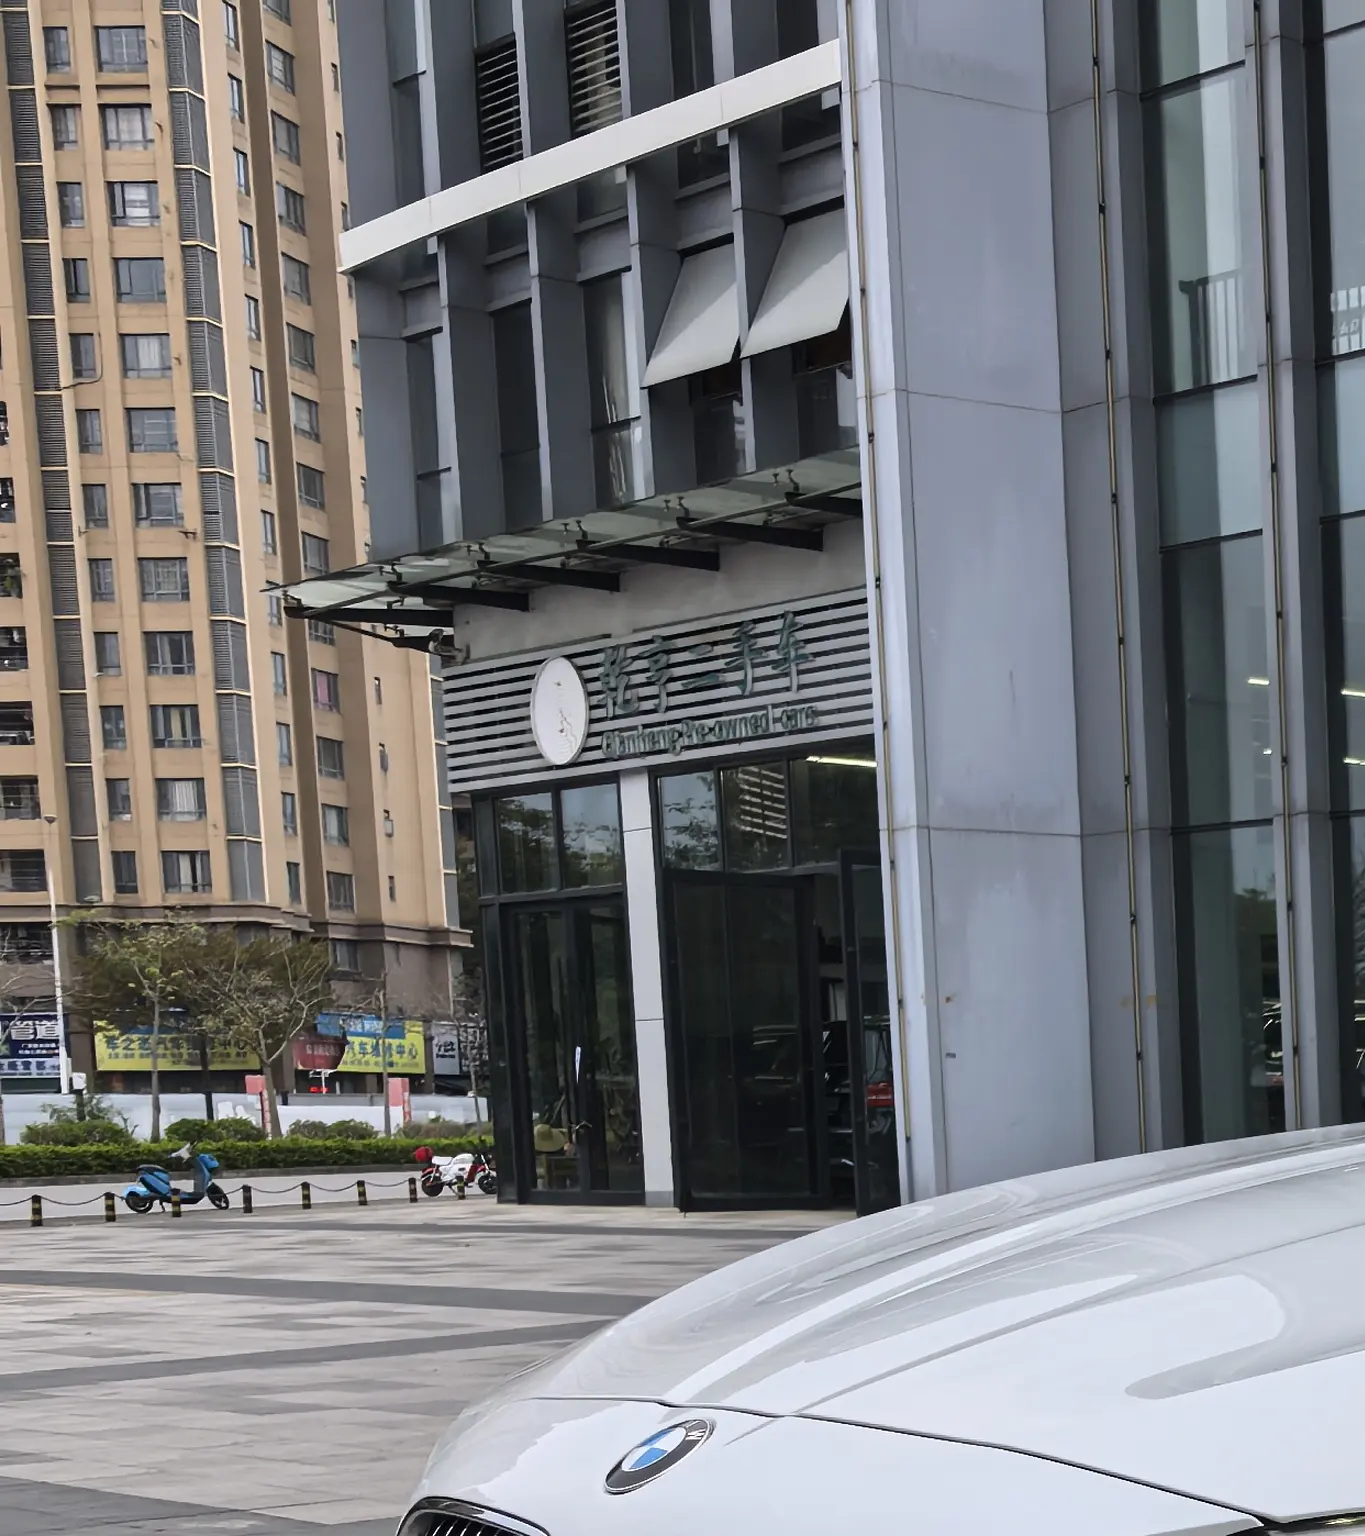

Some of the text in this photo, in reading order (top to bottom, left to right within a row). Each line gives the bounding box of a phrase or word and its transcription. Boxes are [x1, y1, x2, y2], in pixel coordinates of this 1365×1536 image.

[599, 610, 815, 719] 乾亨二手车
